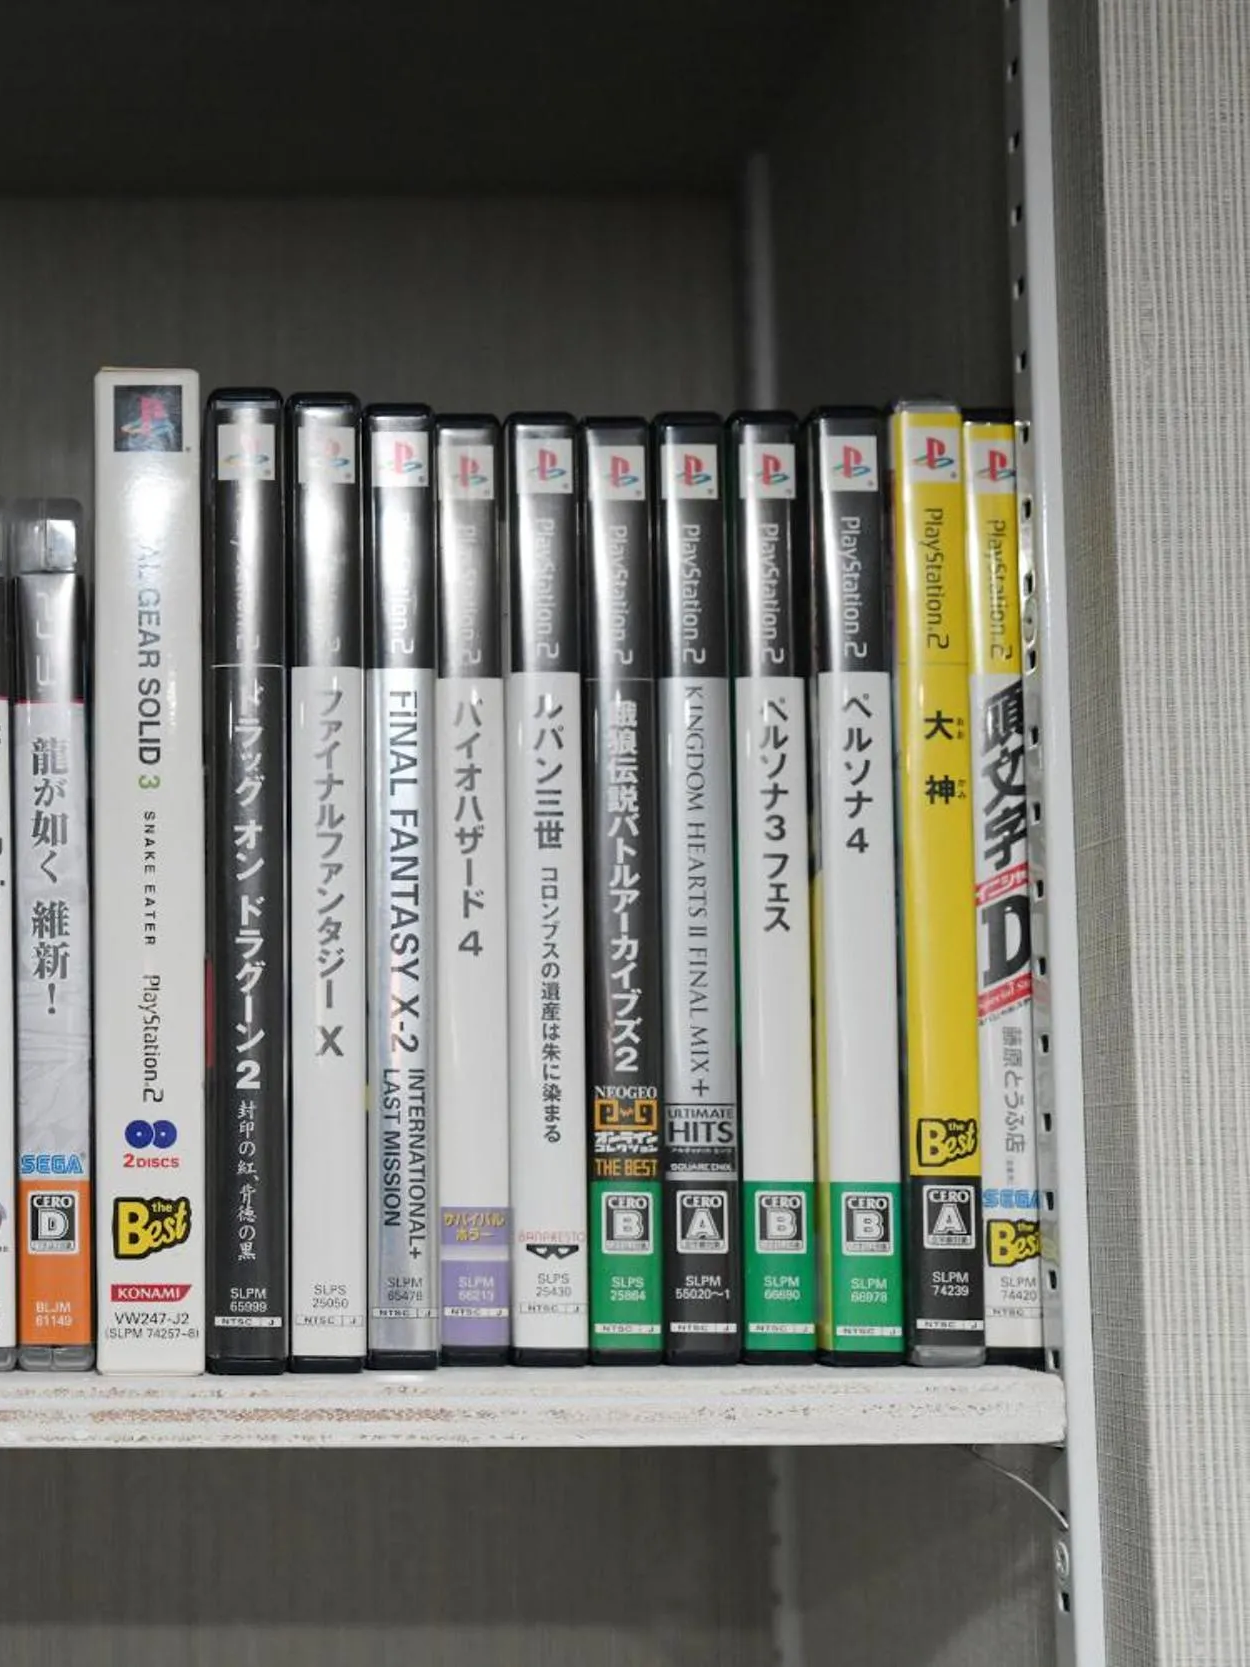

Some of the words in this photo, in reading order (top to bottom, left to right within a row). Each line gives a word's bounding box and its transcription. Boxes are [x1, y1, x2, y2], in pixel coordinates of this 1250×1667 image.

[137, 587, 161, 669] GEAR
[137, 678, 161, 766] SOLID
[389, 690, 418, 797] FINAL
[683, 685, 708, 812] KINGDOM
[137, 774, 161, 791] 3
[31, 737, 69, 884] 龍が如く
[143, 810, 156, 874] SNAKE
[686, 822, 708, 917] HEARTS
[389, 808, 420, 981] FANTASY
[143, 884, 156, 946] EATER
[981, 894, 1032, 988] D
[688, 944, 709, 1018] FINAL
[390, 994, 420, 1053] X-2
[690, 1027, 710, 1074] MIX
[382, 1068, 401, 1125] LAST
[594, 1085, 658, 1099] NEOGEO
[667, 1108, 735, 1120] ULTIMATE
[668, 1121, 735, 1144] HITS
[919, 1120, 978, 1166] Best
[20, 1153, 84, 1175] SEGA
[595, 1158, 621, 1177] THE
[624, 1158, 659, 1177] BEST
[382, 1131, 401, 1227] MISSION
[32, 1195, 73, 1209] CERO
[607, 1196, 648, 1209] CERO
[682, 1195, 723, 1209] CERO
[760, 1196, 801, 1209] CERO
[846, 1197, 888, 1210] CERO
[928, 1189, 969, 1203] CERO
[982, 1188, 1042, 1209] SEGA
[151, 1202, 173, 1214] the
[932, 1203, 967, 1234] A
[37, 1208, 70, 1241] D
[116, 1200, 188, 1258] Best
[613, 1209, 643, 1240] B
[685, 1209, 720, 1240] A
[766, 1209, 796, 1239] B
[852, 1210, 884, 1241] B
[611, 1276, 645, 1288] SLPS
[685, 1275, 722, 1287] SLPM
[763, 1275, 800, 1287] SLPM
[850, 1277, 888, 1290] SLPM
[932, 1271, 969, 1283] SLPM
[1000, 1276, 1037, 1288] SLPM
[117, 1287, 181, 1300] KONAMI
[229, 1287, 267, 1300] SLPM
[313, 1284, 347, 1295] SLPS
[932, 1284, 969, 1296] 74239
[114, 1312, 190, 1326] VW247-J2
